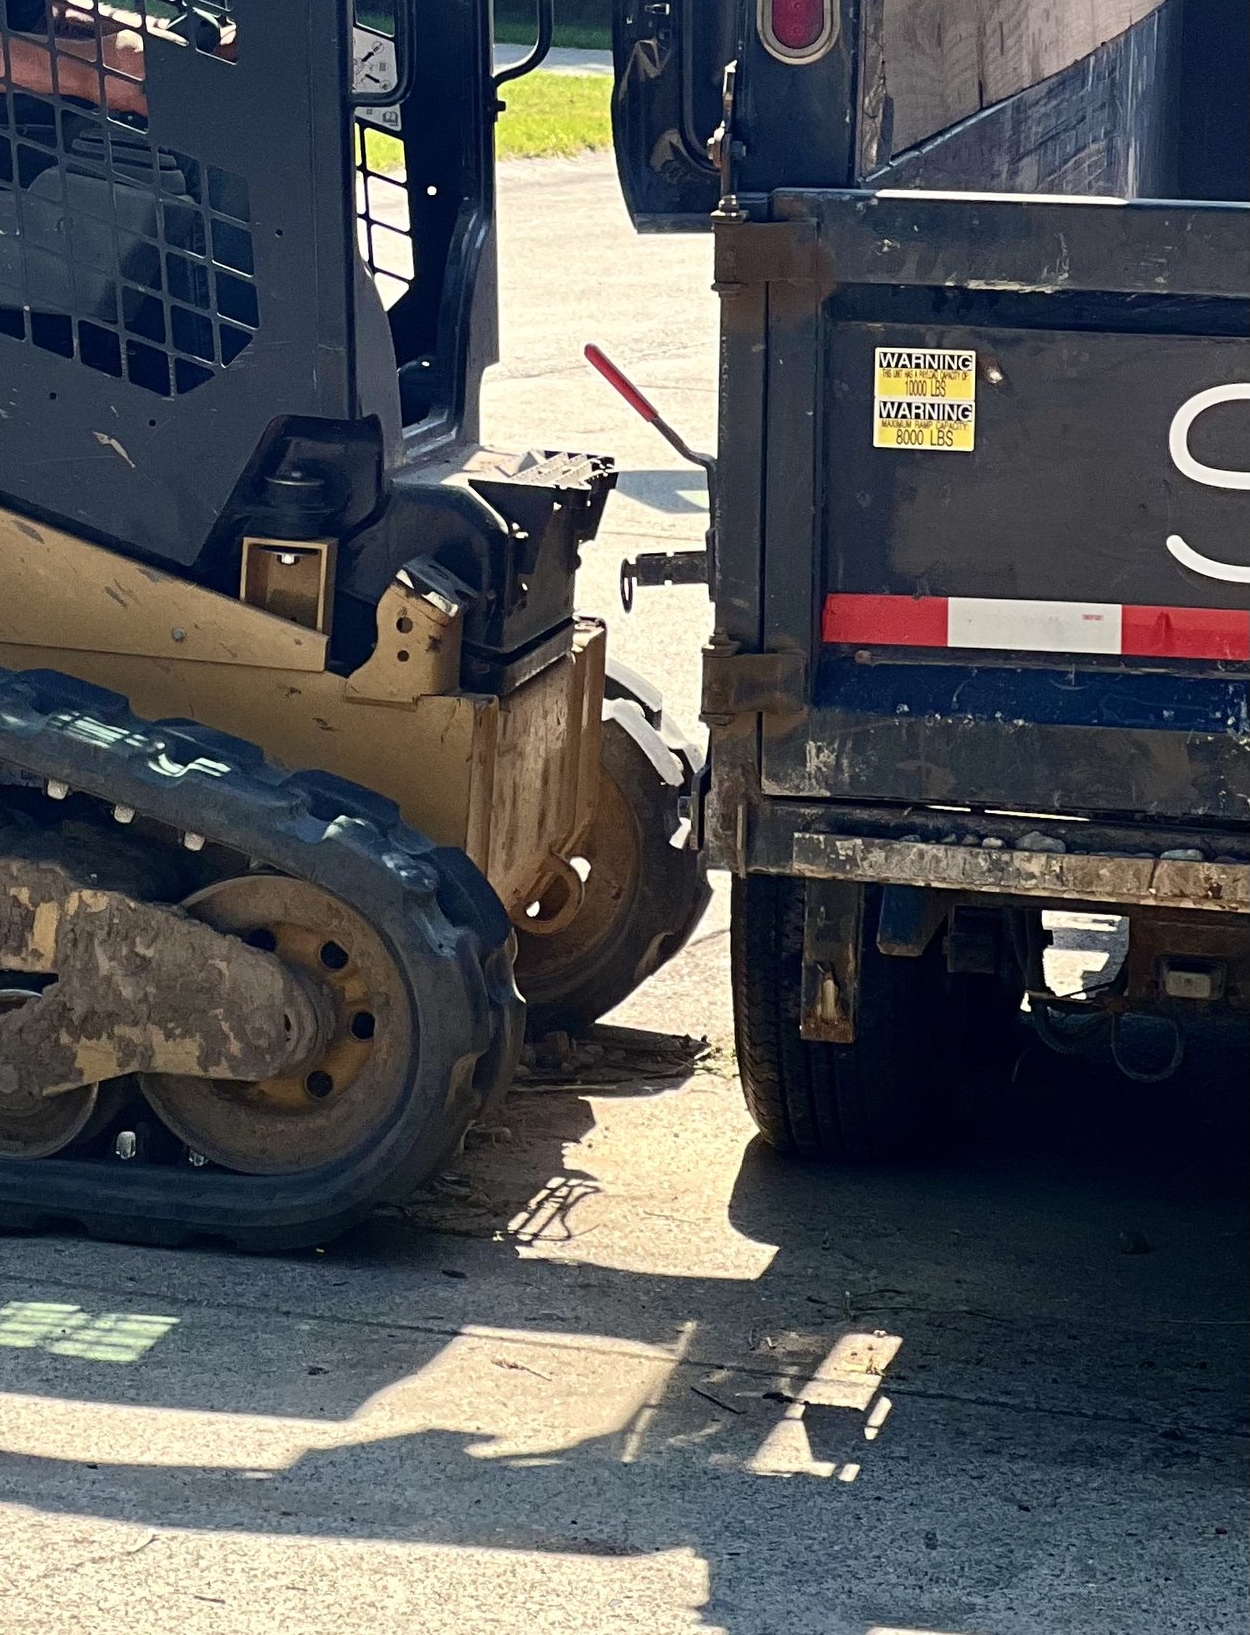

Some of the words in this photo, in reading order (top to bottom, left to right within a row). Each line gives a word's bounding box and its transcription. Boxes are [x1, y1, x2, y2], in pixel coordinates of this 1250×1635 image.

[880, 352, 972, 371] WARNING
[882, 369, 891, 378] THIS
[893, 370, 902, 379] UNIT
[905, 371, 913, 379] HAS
[919, 370, 938, 380] PAYLOAD
[940, 372, 960, 381] CAPACITY
[905, 380, 927, 396] 10000
[931, 380, 946, 397] LBS
[880, 401, 972, 421] WARNING
[882, 419, 911, 429] MAXIMUM
[915, 420, 931, 429] RAMP
[896, 429, 924, 445] 8000
[930, 430, 953, 447] LBS
